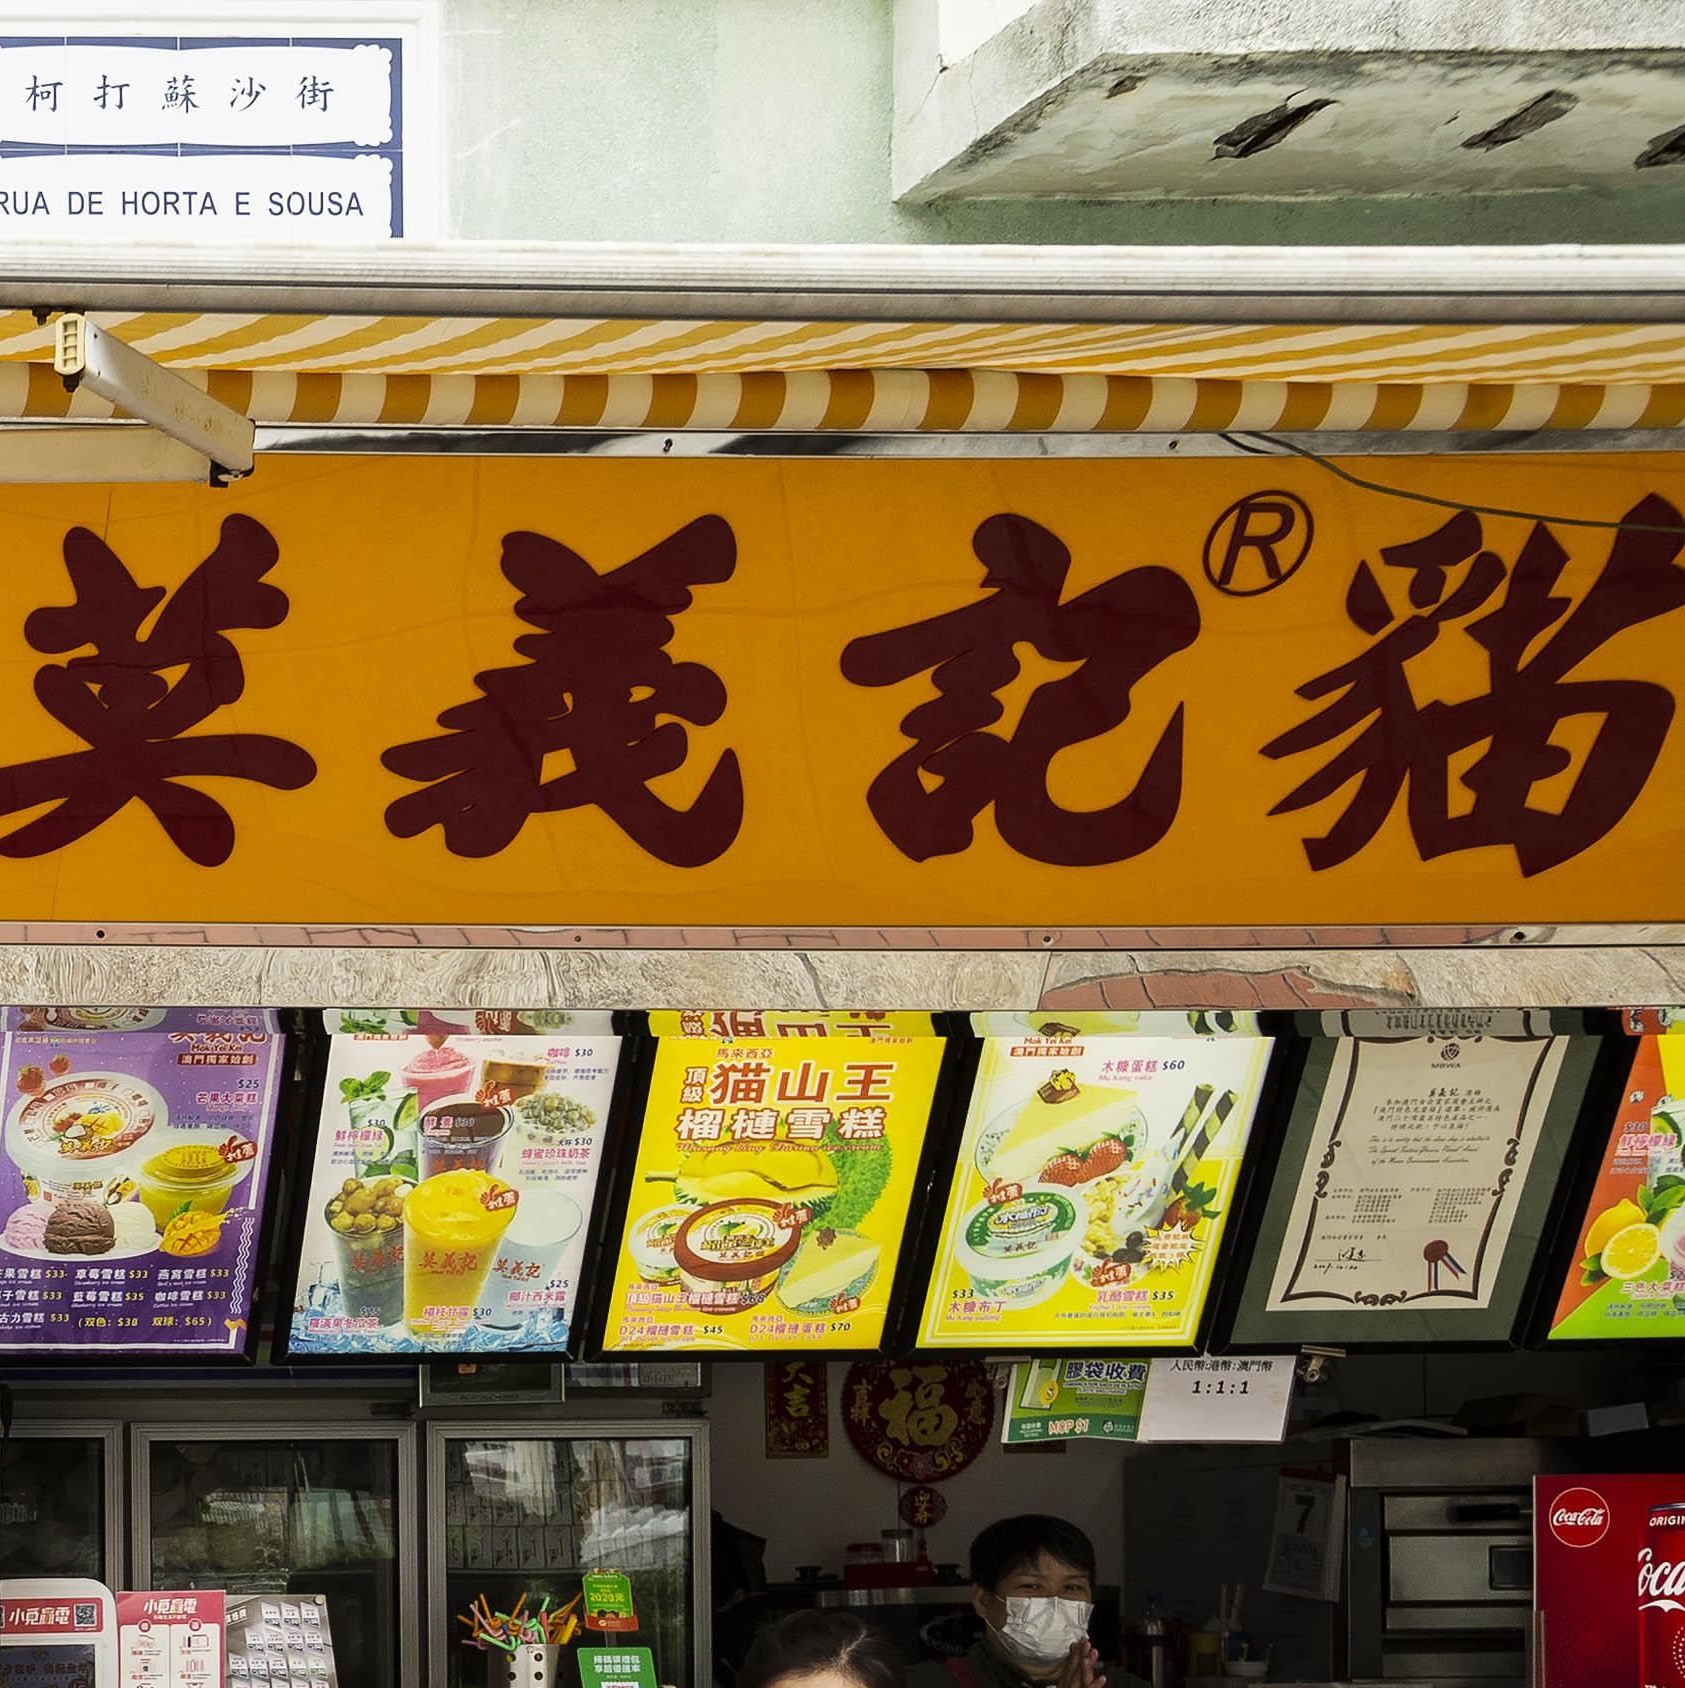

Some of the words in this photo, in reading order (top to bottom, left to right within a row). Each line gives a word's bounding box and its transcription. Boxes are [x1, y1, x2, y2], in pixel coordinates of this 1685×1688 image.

[26, 75, 334, 113] 柯打蘇沙街
[69, 191, 103, 217] DE
[121, 191, 216, 217] HORTA
[236, 191, 250, 217] E
[268, 191, 364, 217] SOUSA
[716, 1048, 773, 1059] 馬來西亞
[710, 1062, 896, 1103] 猫山王
[675, 1107, 886, 1140] 榴槤雪糕
[1065, 1361, 1147, 1381] 膠袋收費
[878, 1365, 958, 1447] 福
